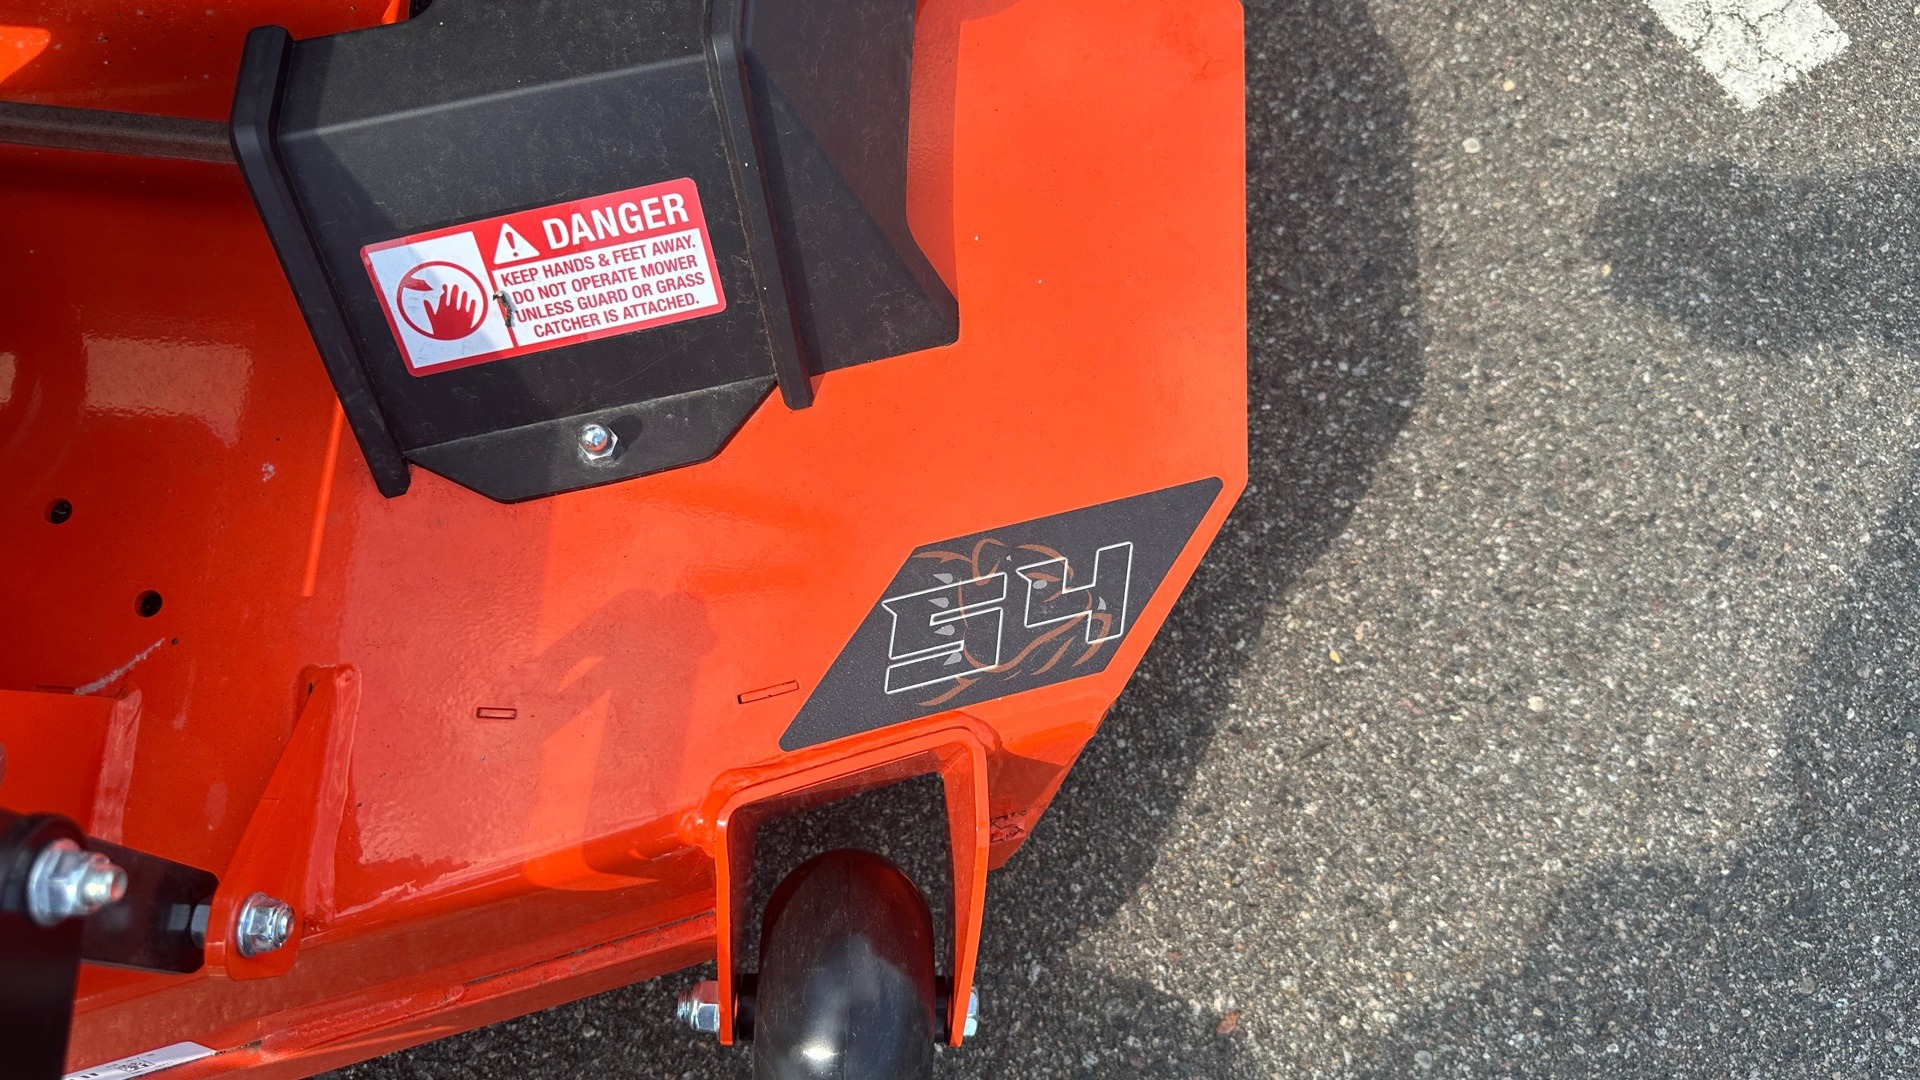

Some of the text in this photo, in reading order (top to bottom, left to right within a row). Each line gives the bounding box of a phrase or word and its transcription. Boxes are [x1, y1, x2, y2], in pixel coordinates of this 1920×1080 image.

[542, 193, 689, 250] DANGER
[500, 234, 696, 287] KEEP HANDS & FEET AWAY.
[513, 255, 698, 305] DO NOT OPERATE MOWER
[516, 272, 705, 323] UNLESS GUARD OR GRASS
[534, 293, 699, 338] CATCHER IS ATTACHED.
[882, 541, 1133, 694] 54
